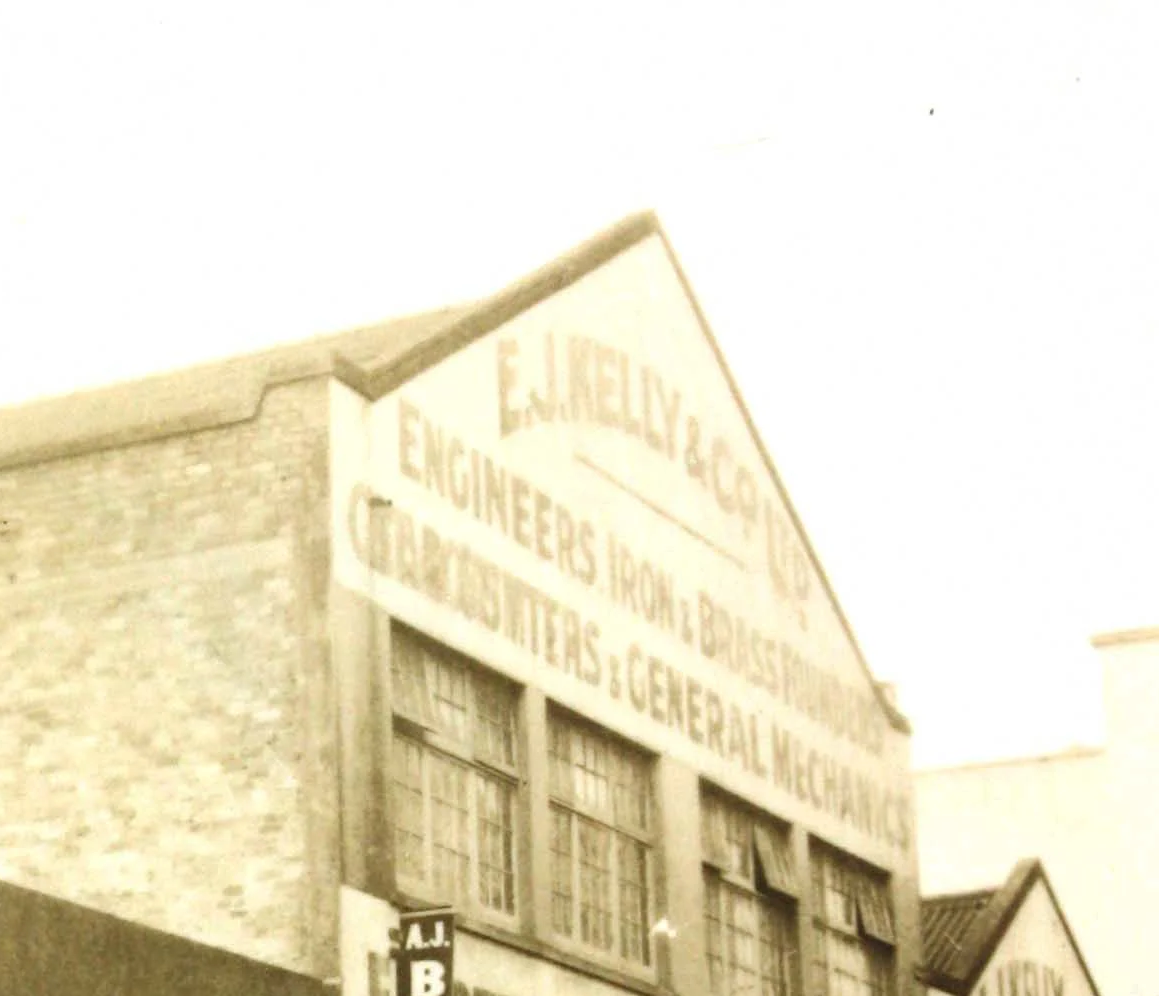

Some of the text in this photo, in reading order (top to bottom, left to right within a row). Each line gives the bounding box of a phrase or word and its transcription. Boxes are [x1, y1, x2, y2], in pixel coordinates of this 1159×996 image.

[398, 398, 596, 587] ENGINEERS
[608, 533, 674, 630] IRON
[626, 638, 768, 782] GENERAL
[771, 718, 912, 858] MECHANICS
[406, 921, 451, 950] A.J.
